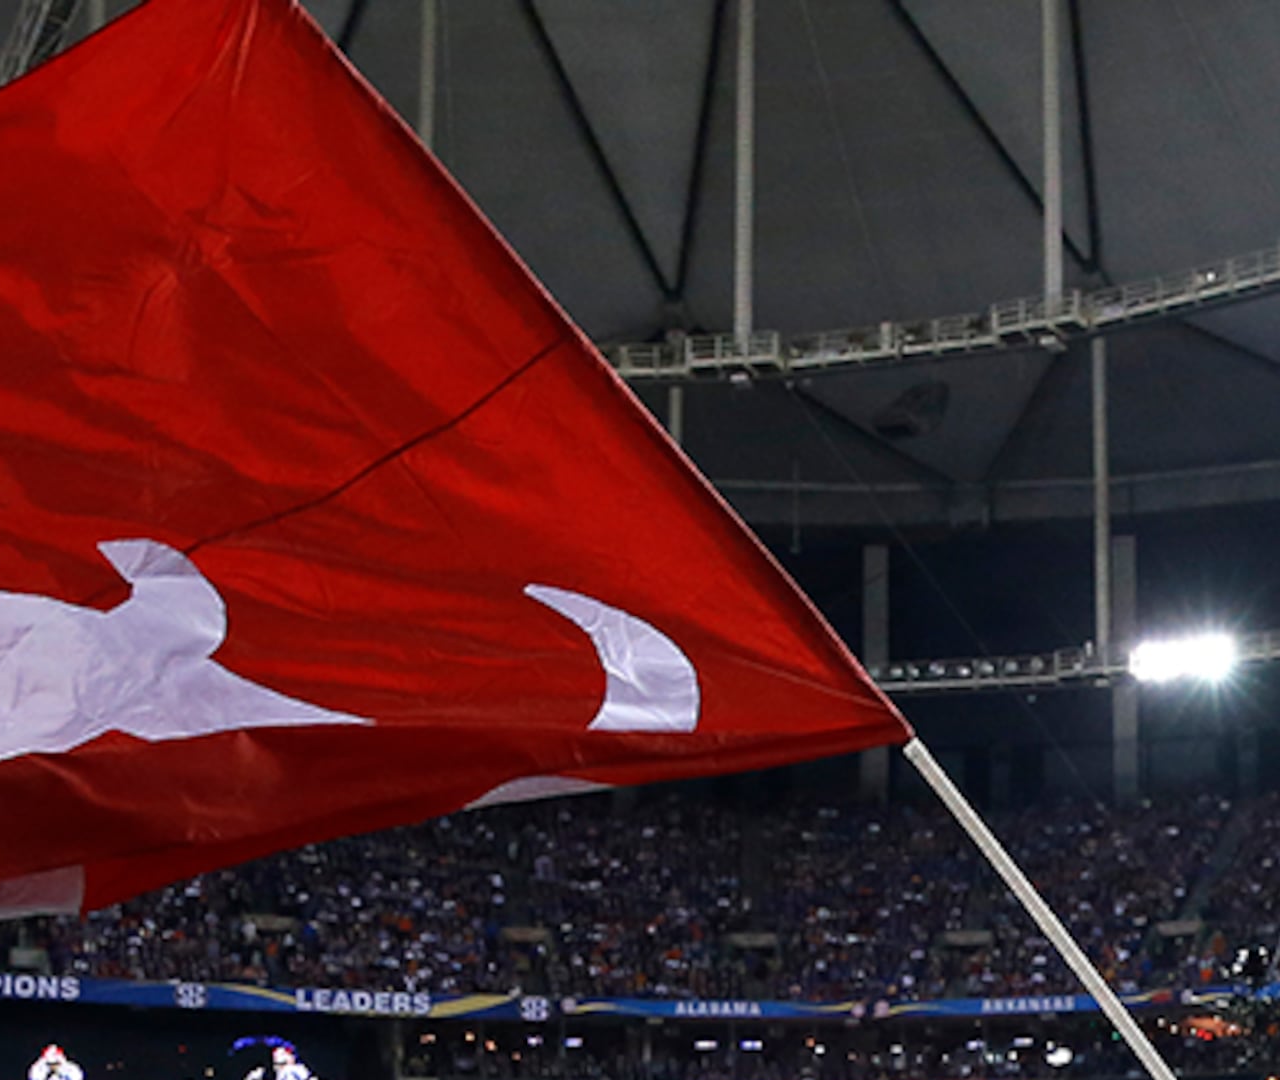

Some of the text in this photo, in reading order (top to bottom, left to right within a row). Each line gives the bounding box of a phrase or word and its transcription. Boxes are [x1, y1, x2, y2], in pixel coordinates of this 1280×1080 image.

[295, 988, 432, 1015] LEADERS
[675, 1001, 762, 1017] ALABAMA
[981, 995, 1076, 1013] ARKANSAS
